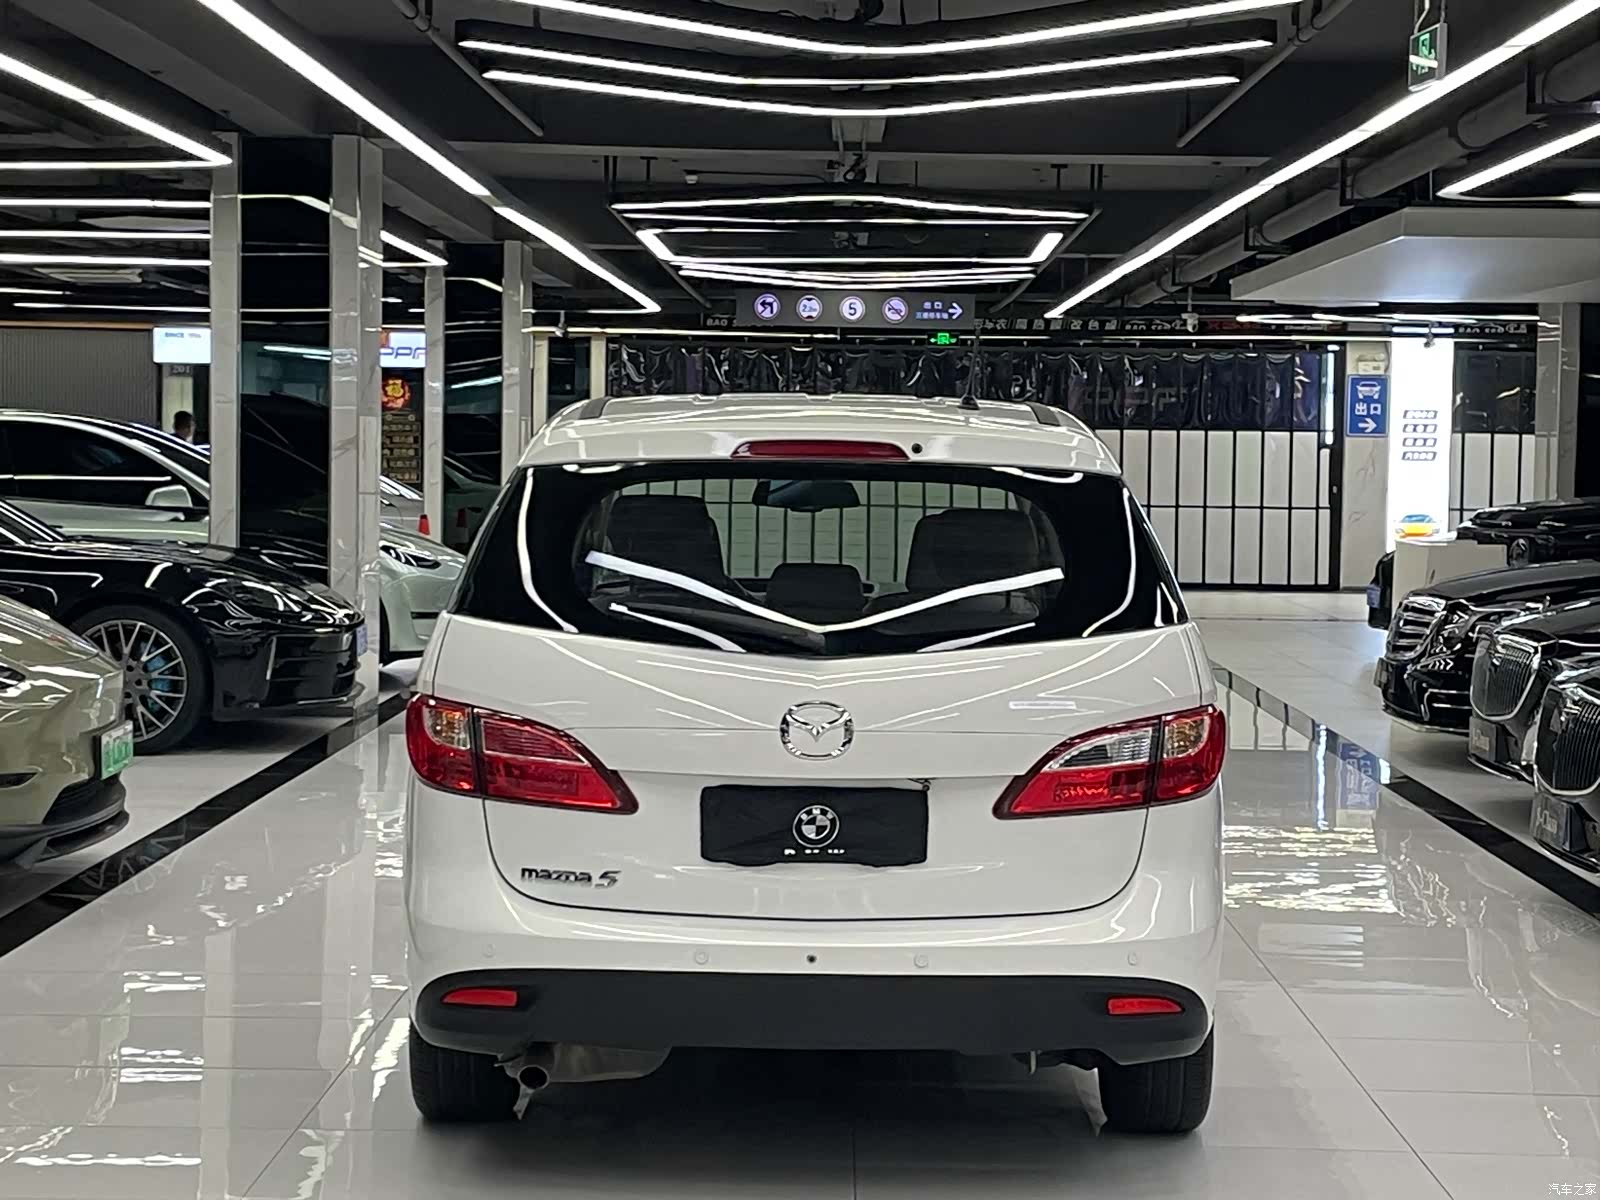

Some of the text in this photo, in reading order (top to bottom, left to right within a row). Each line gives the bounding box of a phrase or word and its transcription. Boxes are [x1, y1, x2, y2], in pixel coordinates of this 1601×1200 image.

[848, 302, 858, 317] 5
[1355, 401, 1382, 416] 出口
[594, 870, 622, 889] 5
